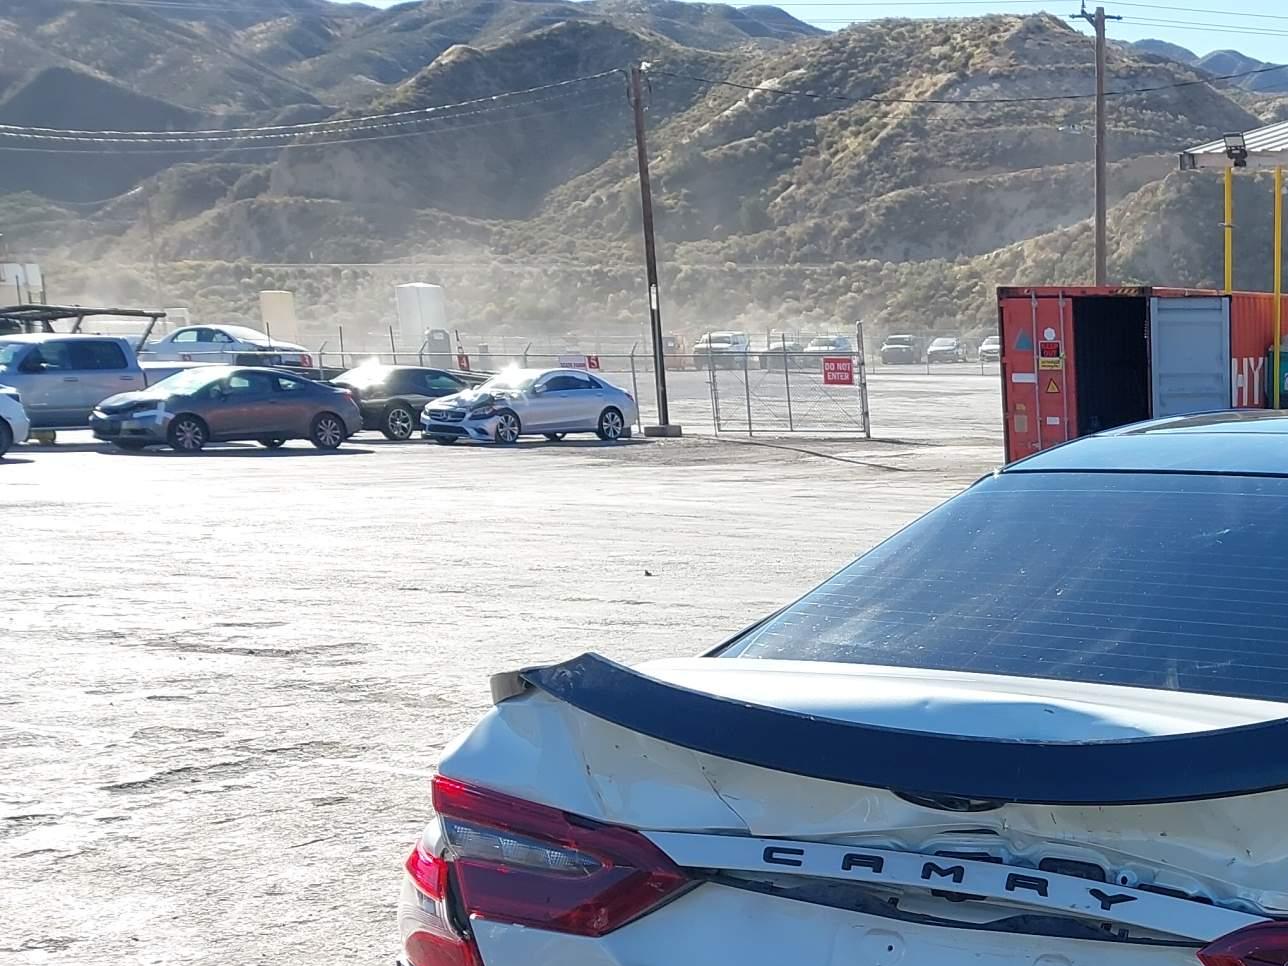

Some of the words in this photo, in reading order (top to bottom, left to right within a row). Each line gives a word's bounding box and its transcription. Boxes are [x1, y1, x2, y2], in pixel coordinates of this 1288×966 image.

[824, 362, 835, 371] DO
[837, 362, 851, 371] NOT
[827, 371, 849, 380] ENTER
[762, 845, 1138, 911] CAMRY
